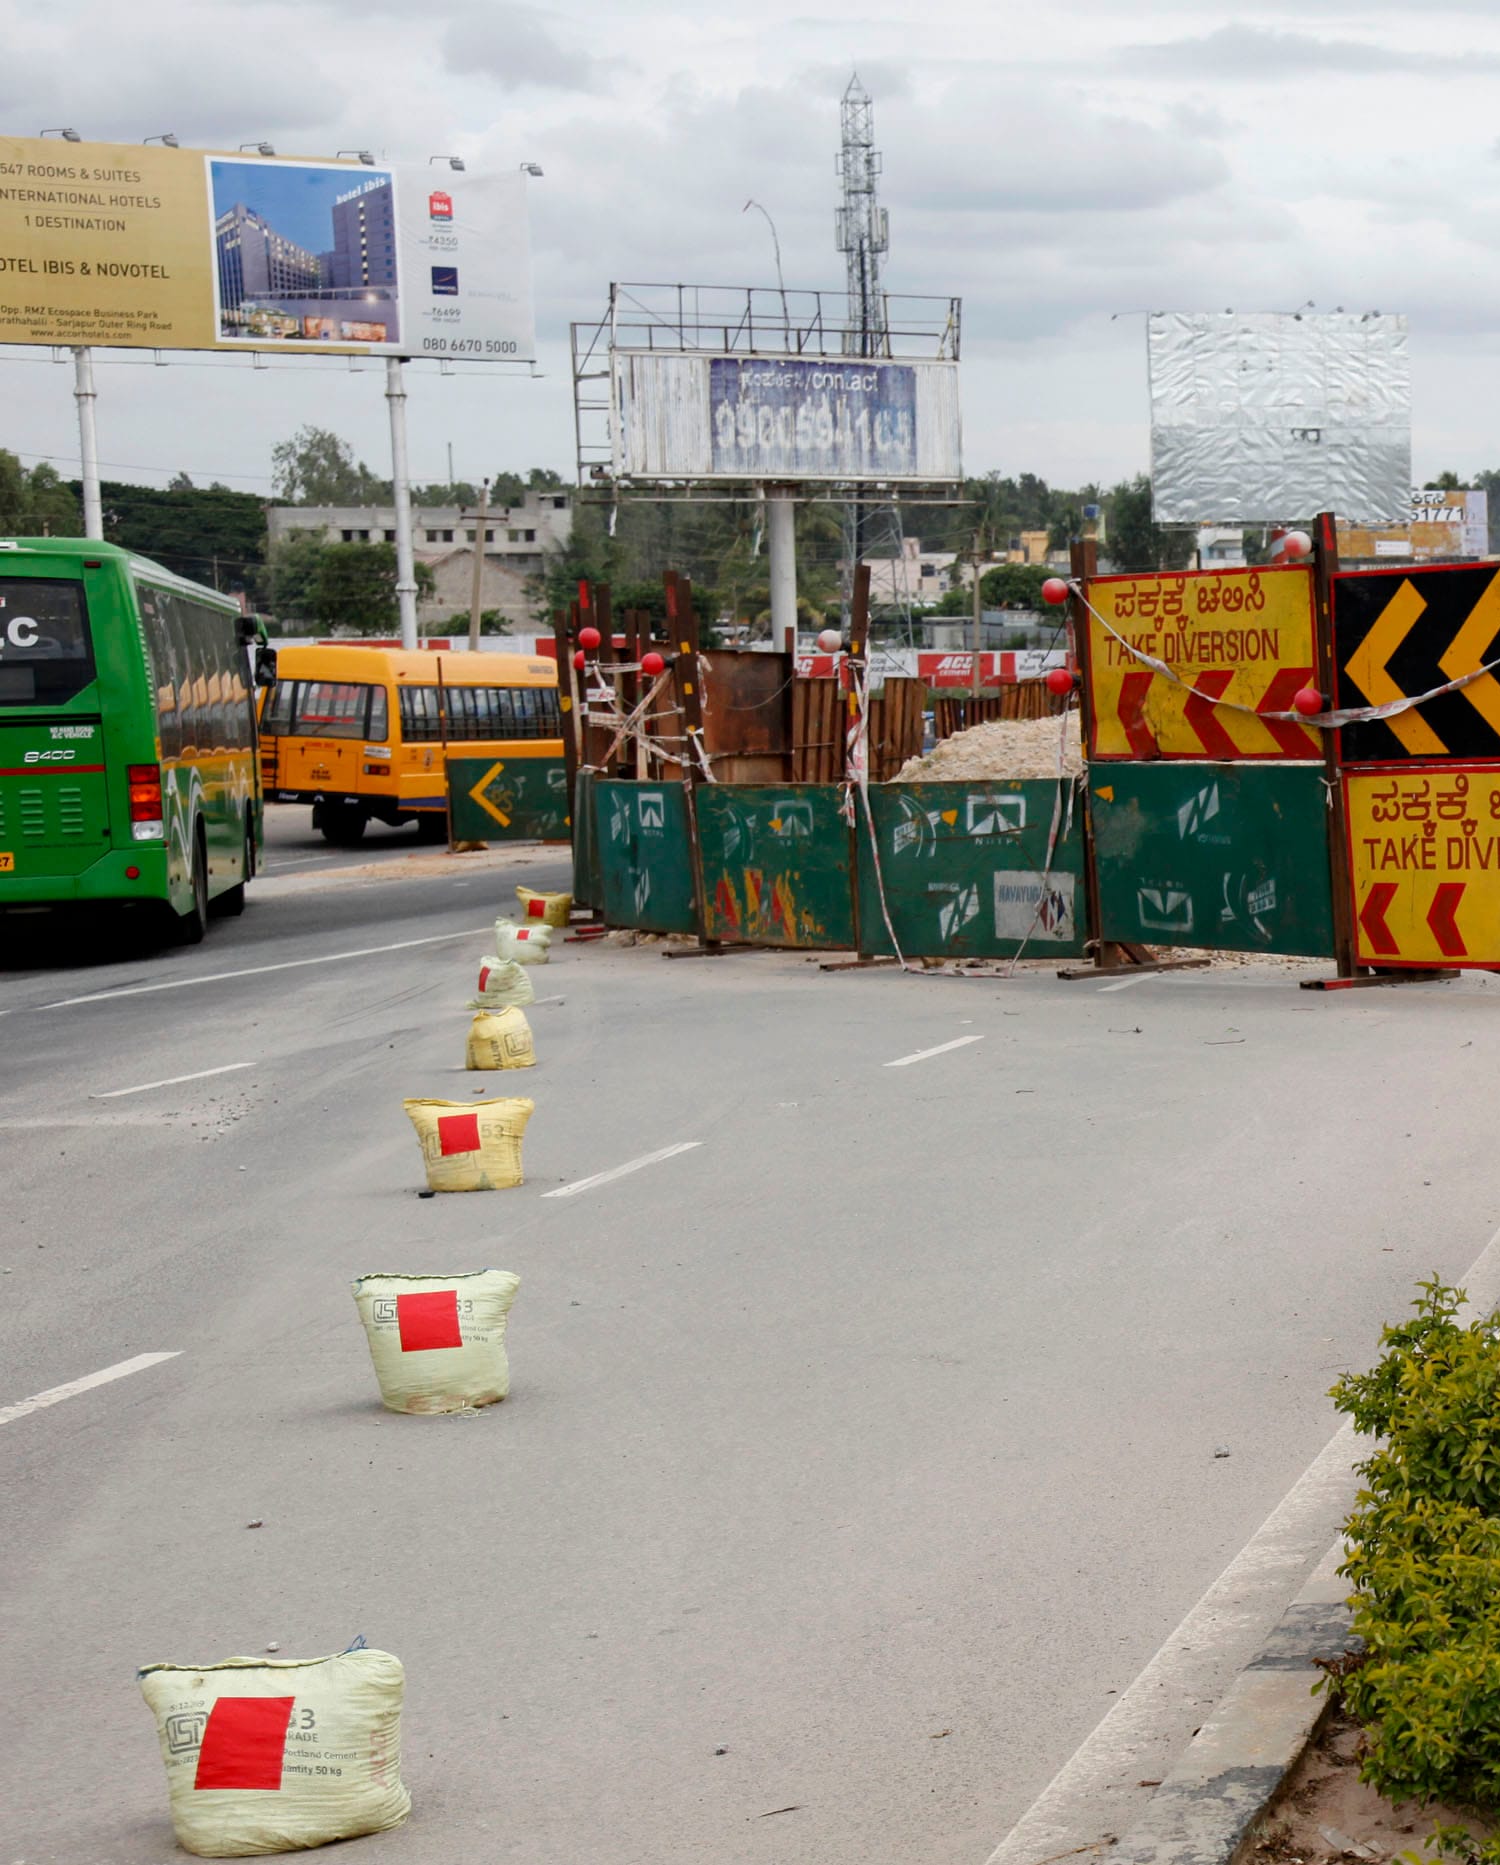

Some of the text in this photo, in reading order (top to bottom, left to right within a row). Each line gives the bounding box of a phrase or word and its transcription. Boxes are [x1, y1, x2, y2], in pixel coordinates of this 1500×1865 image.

[0, 163, 141, 183] 547 ROOMS & SUITES
[364, 176, 386, 193] ibis
[109, 195, 161, 209] HOTELS
[24, 215, 126, 232] 1 DESTINATION
[43, 260, 75, 275] IBIS
[80, 262, 91, 276] &
[97, 263, 170, 279] NOVOTEL
[0, 305, 158, 319] Opp. RMZ Ecospace Business Park
[56, 318, 96, 330] Sarjapur
[99, 320, 124, 328] Outer
[126, 320, 147, 331] Ring
[150, 321, 172, 330] Road
[423, 337, 517, 354] 080 6670 5000
[1104, 628, 1279, 666] TAKE DIVERSION
[936, 656, 974, 669] ACC
[24, 750, 76, 763] 8400
[1363, 835, 1437, 870] TAKE
[480, 1123, 505, 1140] 53
[286, 1731, 319, 1743] RADE
[324, 1751, 357, 1760] Cement
[283, 1765, 342, 1777] antity 50 kg
